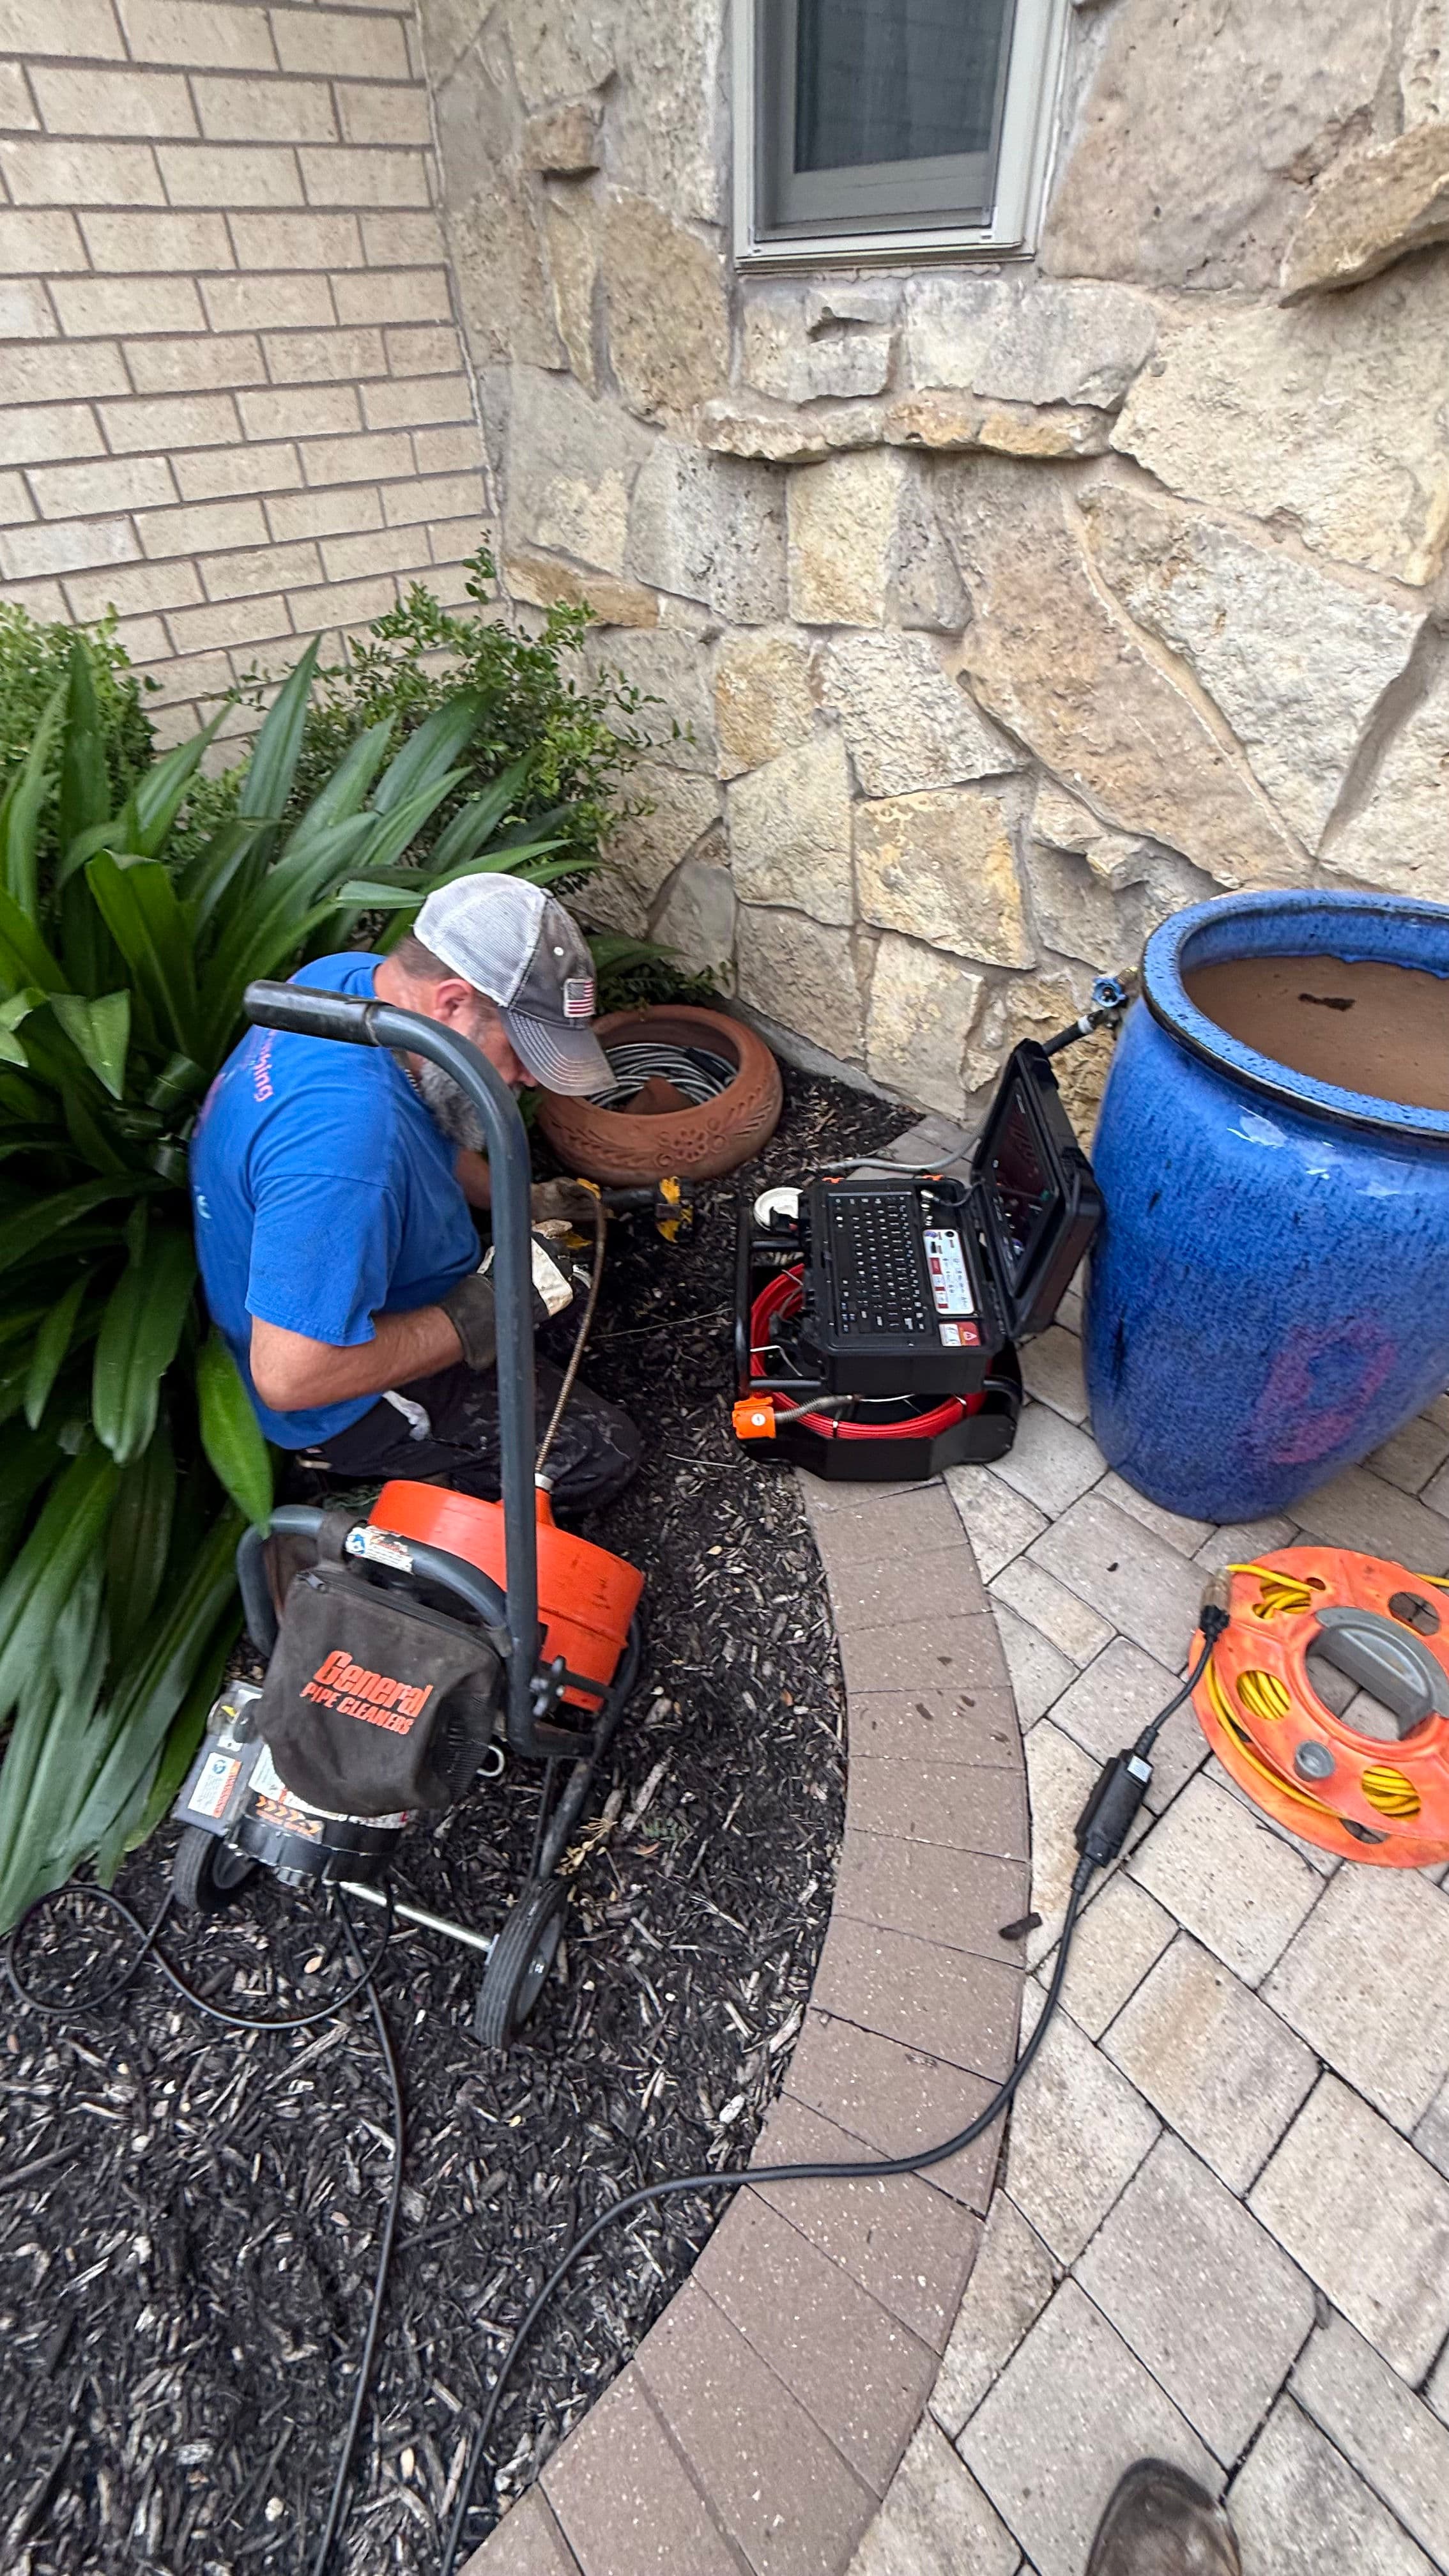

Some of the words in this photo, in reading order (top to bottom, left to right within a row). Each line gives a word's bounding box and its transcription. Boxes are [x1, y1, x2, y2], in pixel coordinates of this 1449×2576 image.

[299, 1682, 342, 1708] PIPE
[336, 1696, 415, 1735] CLEANERS
[313, 1650, 434, 1718] General
